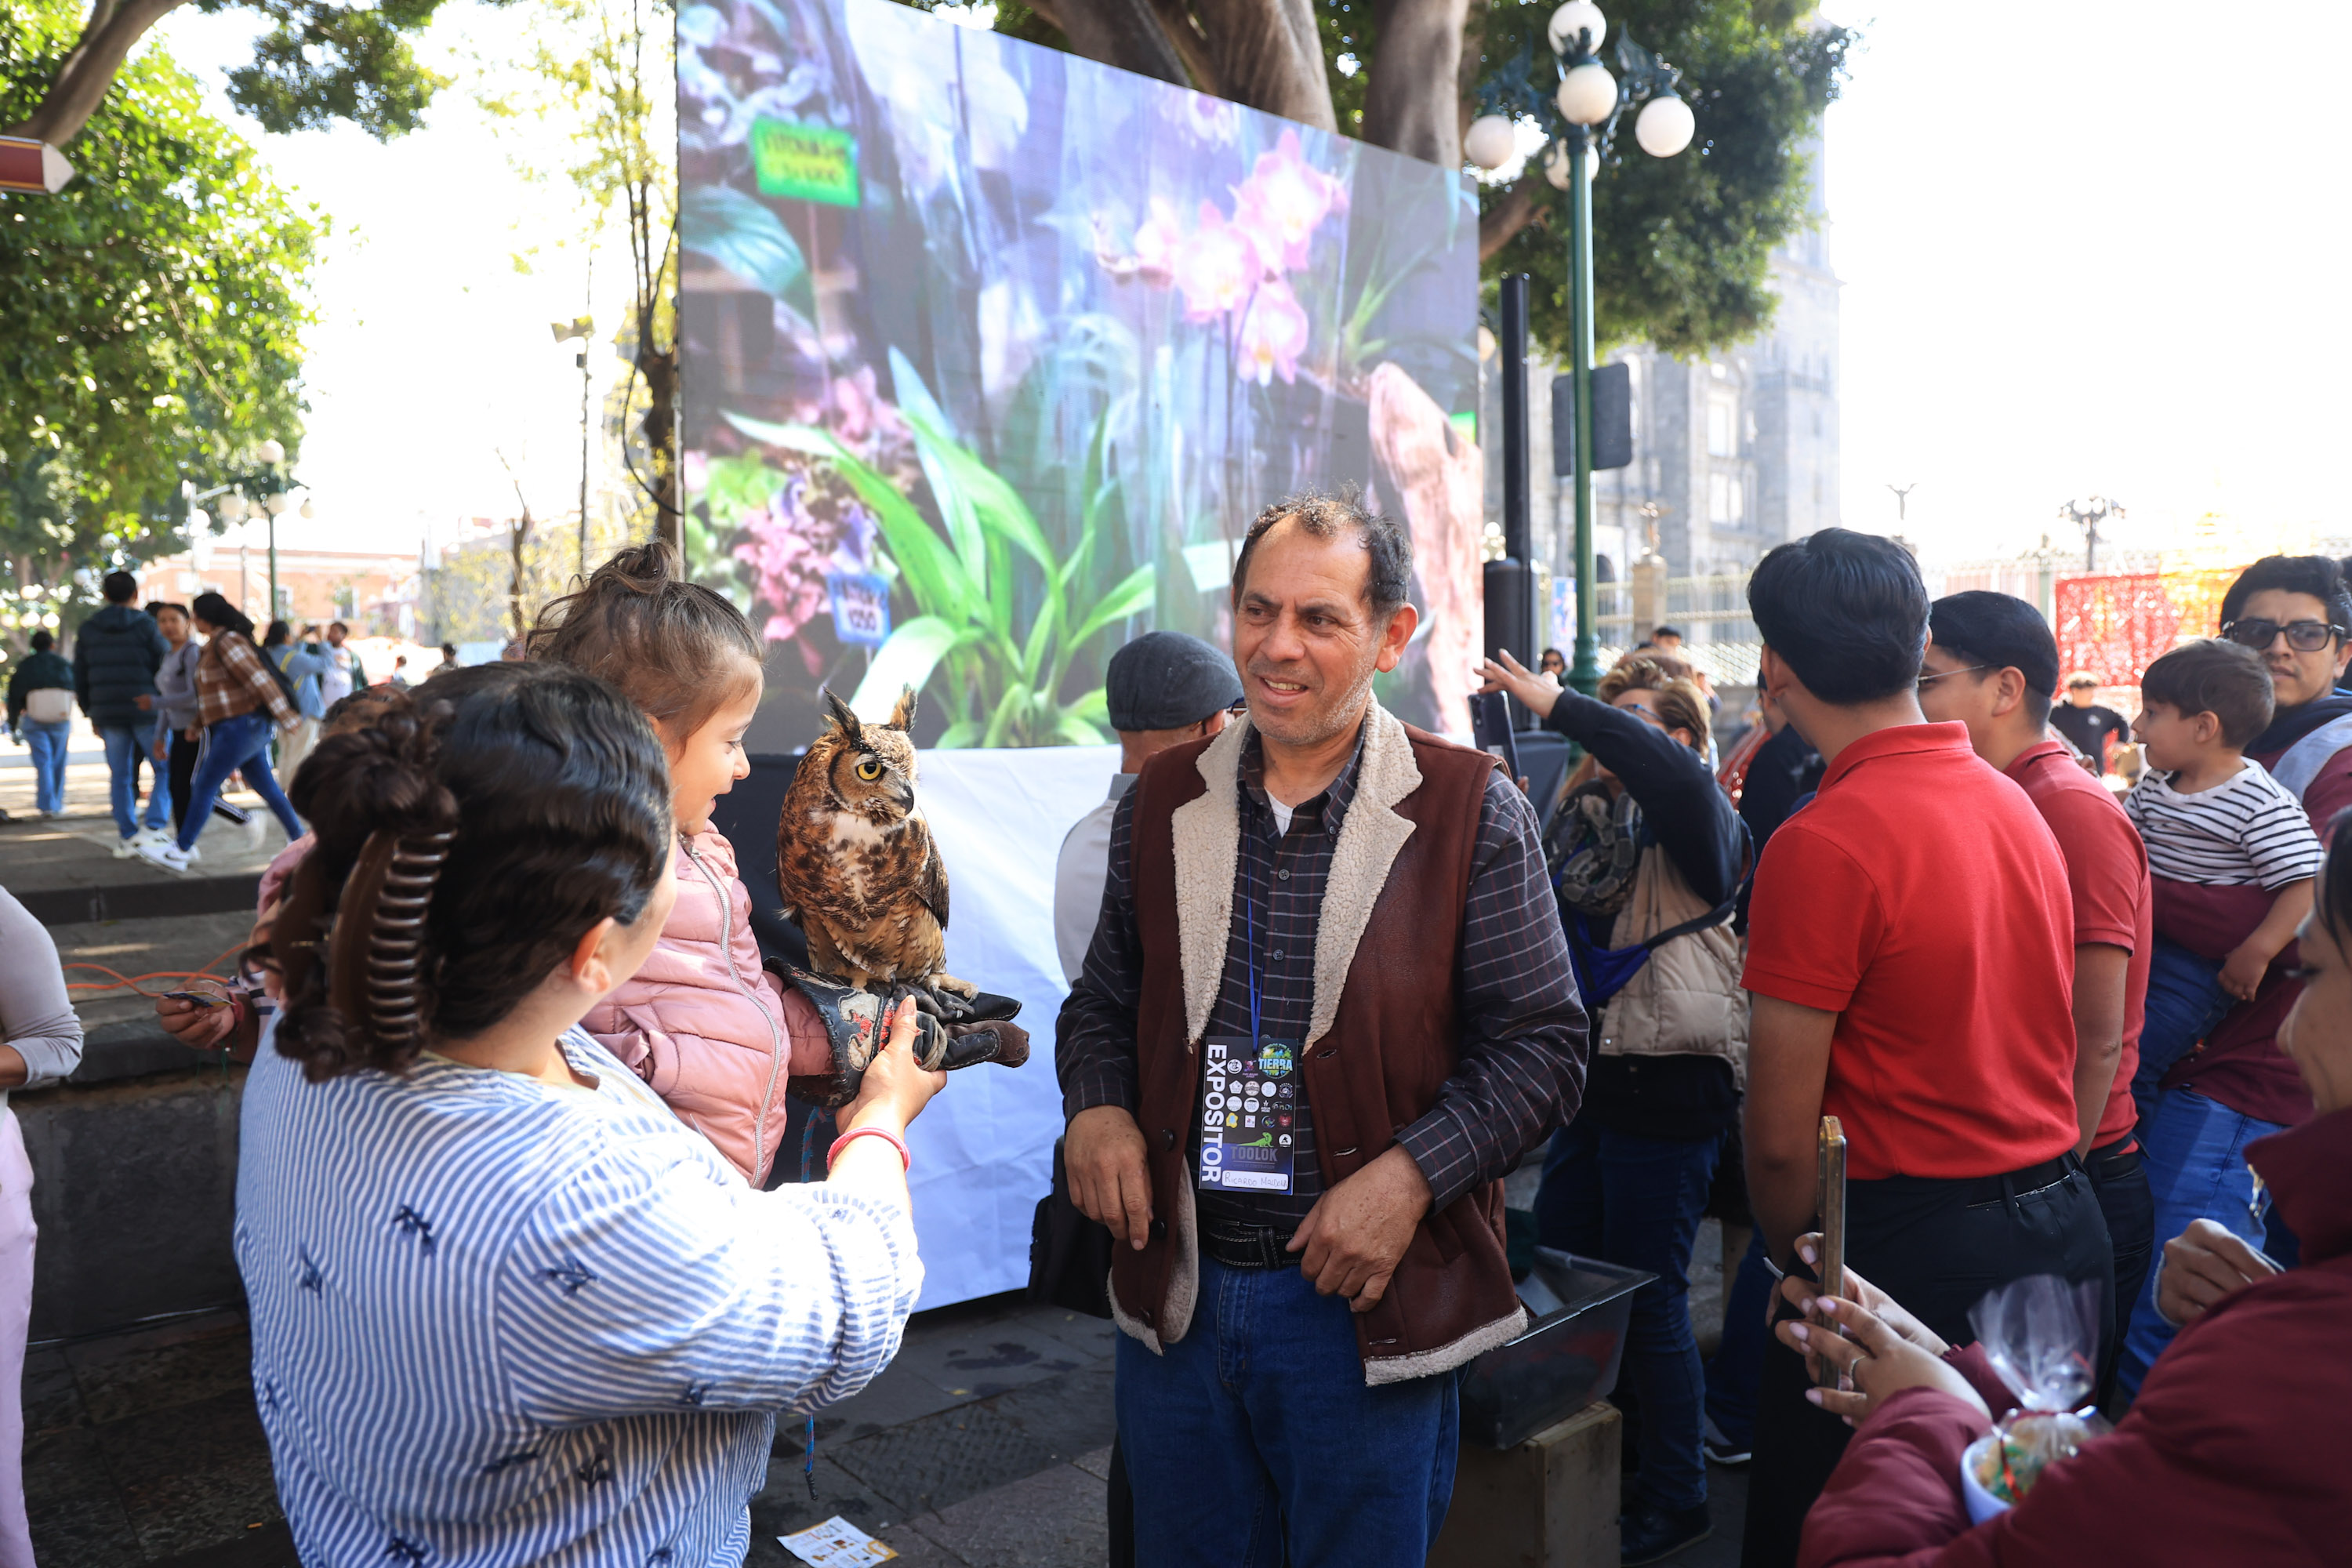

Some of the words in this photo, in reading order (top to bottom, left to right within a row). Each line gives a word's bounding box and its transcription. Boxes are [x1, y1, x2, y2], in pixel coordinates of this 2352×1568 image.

[1258, 1058, 1293, 1072] TIERRA
[1202, 1044, 1228, 1182] EXPOSITOR
[1229, 1145, 1278, 1162] TOOLOK
